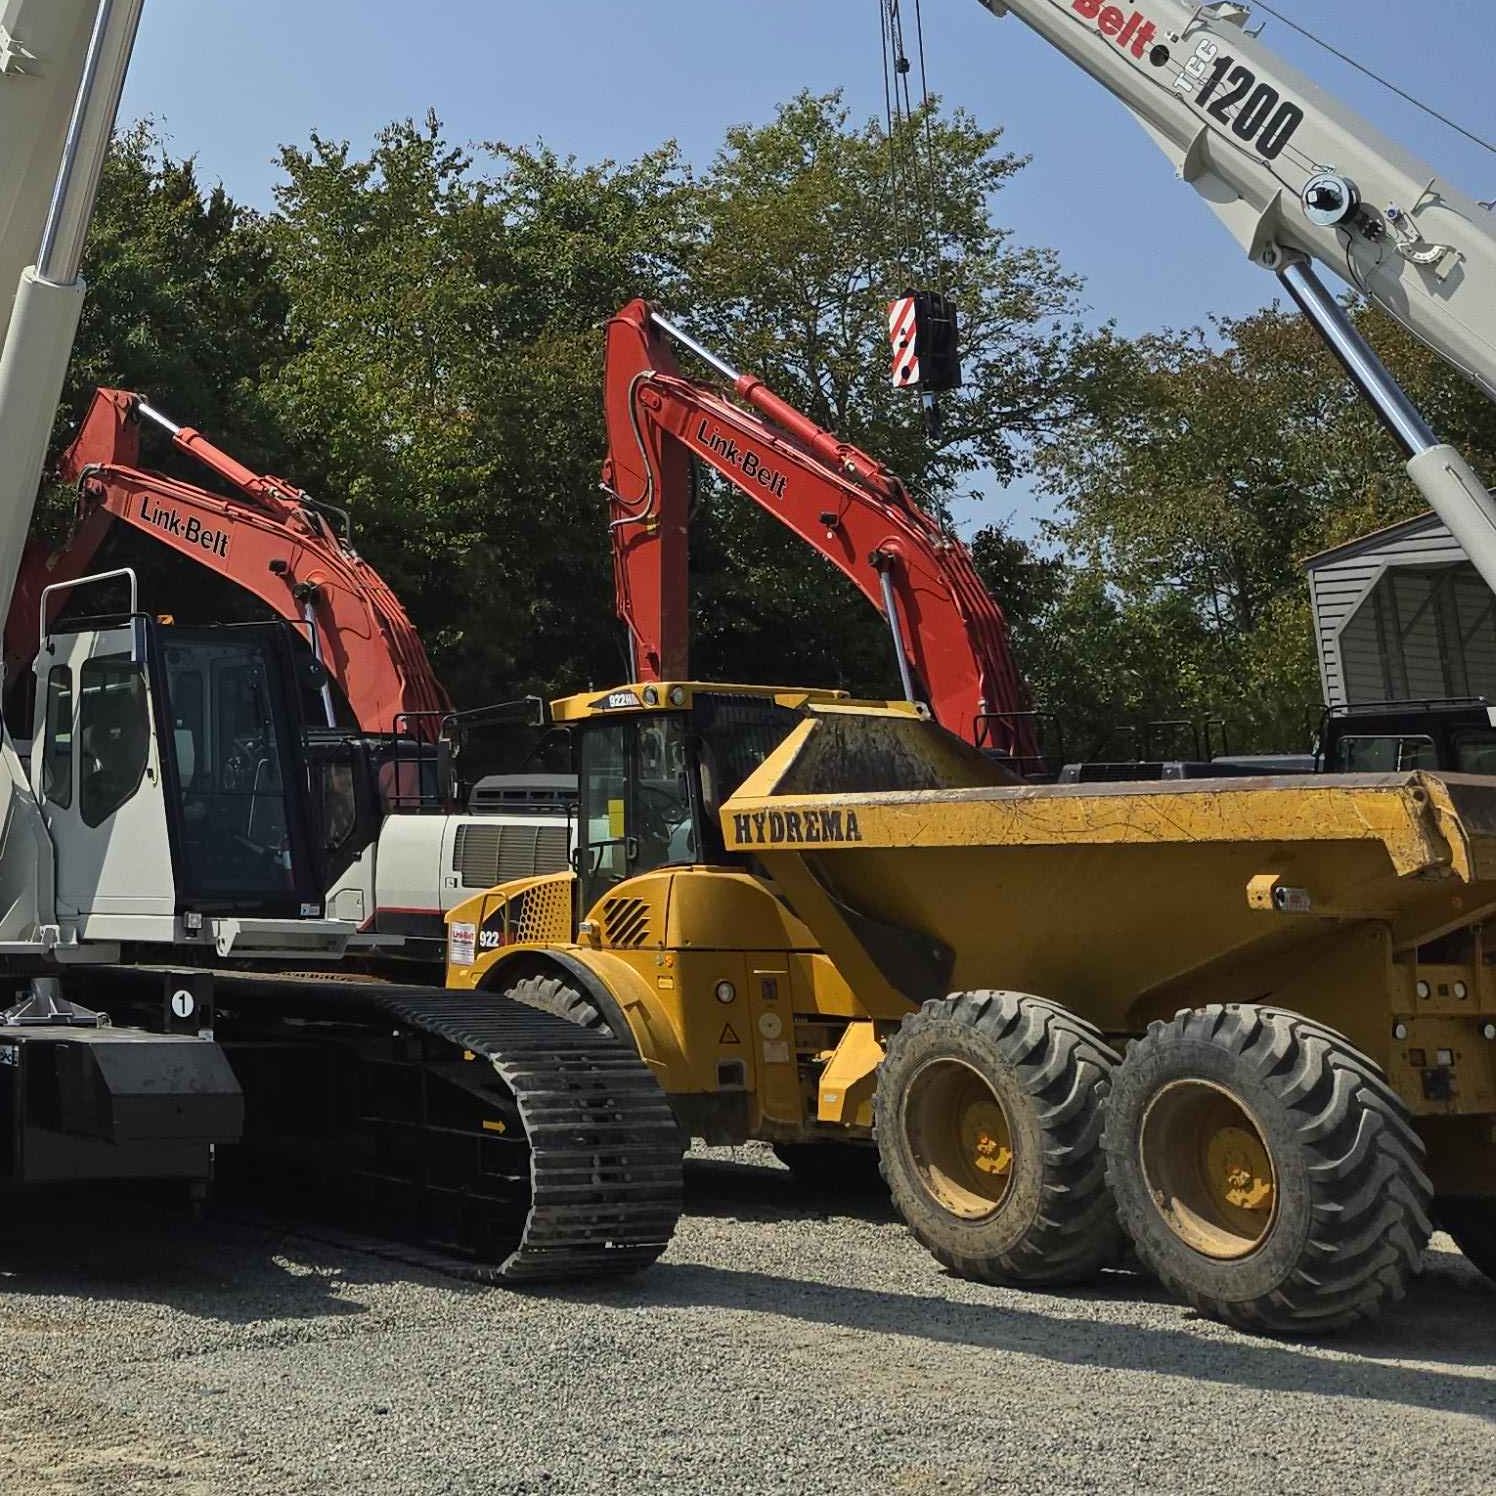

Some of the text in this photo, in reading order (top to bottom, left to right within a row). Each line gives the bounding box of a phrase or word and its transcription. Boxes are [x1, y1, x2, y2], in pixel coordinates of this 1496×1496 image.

[1194, 55, 1304, 161] 1200
[696, 418, 788, 501] Link-Belt
[139, 495, 230, 559] Link-Belt
[732, 809, 862, 844] HYDREMA
[479, 930, 500, 947] 922
[178, 994, 186, 1014] 1
